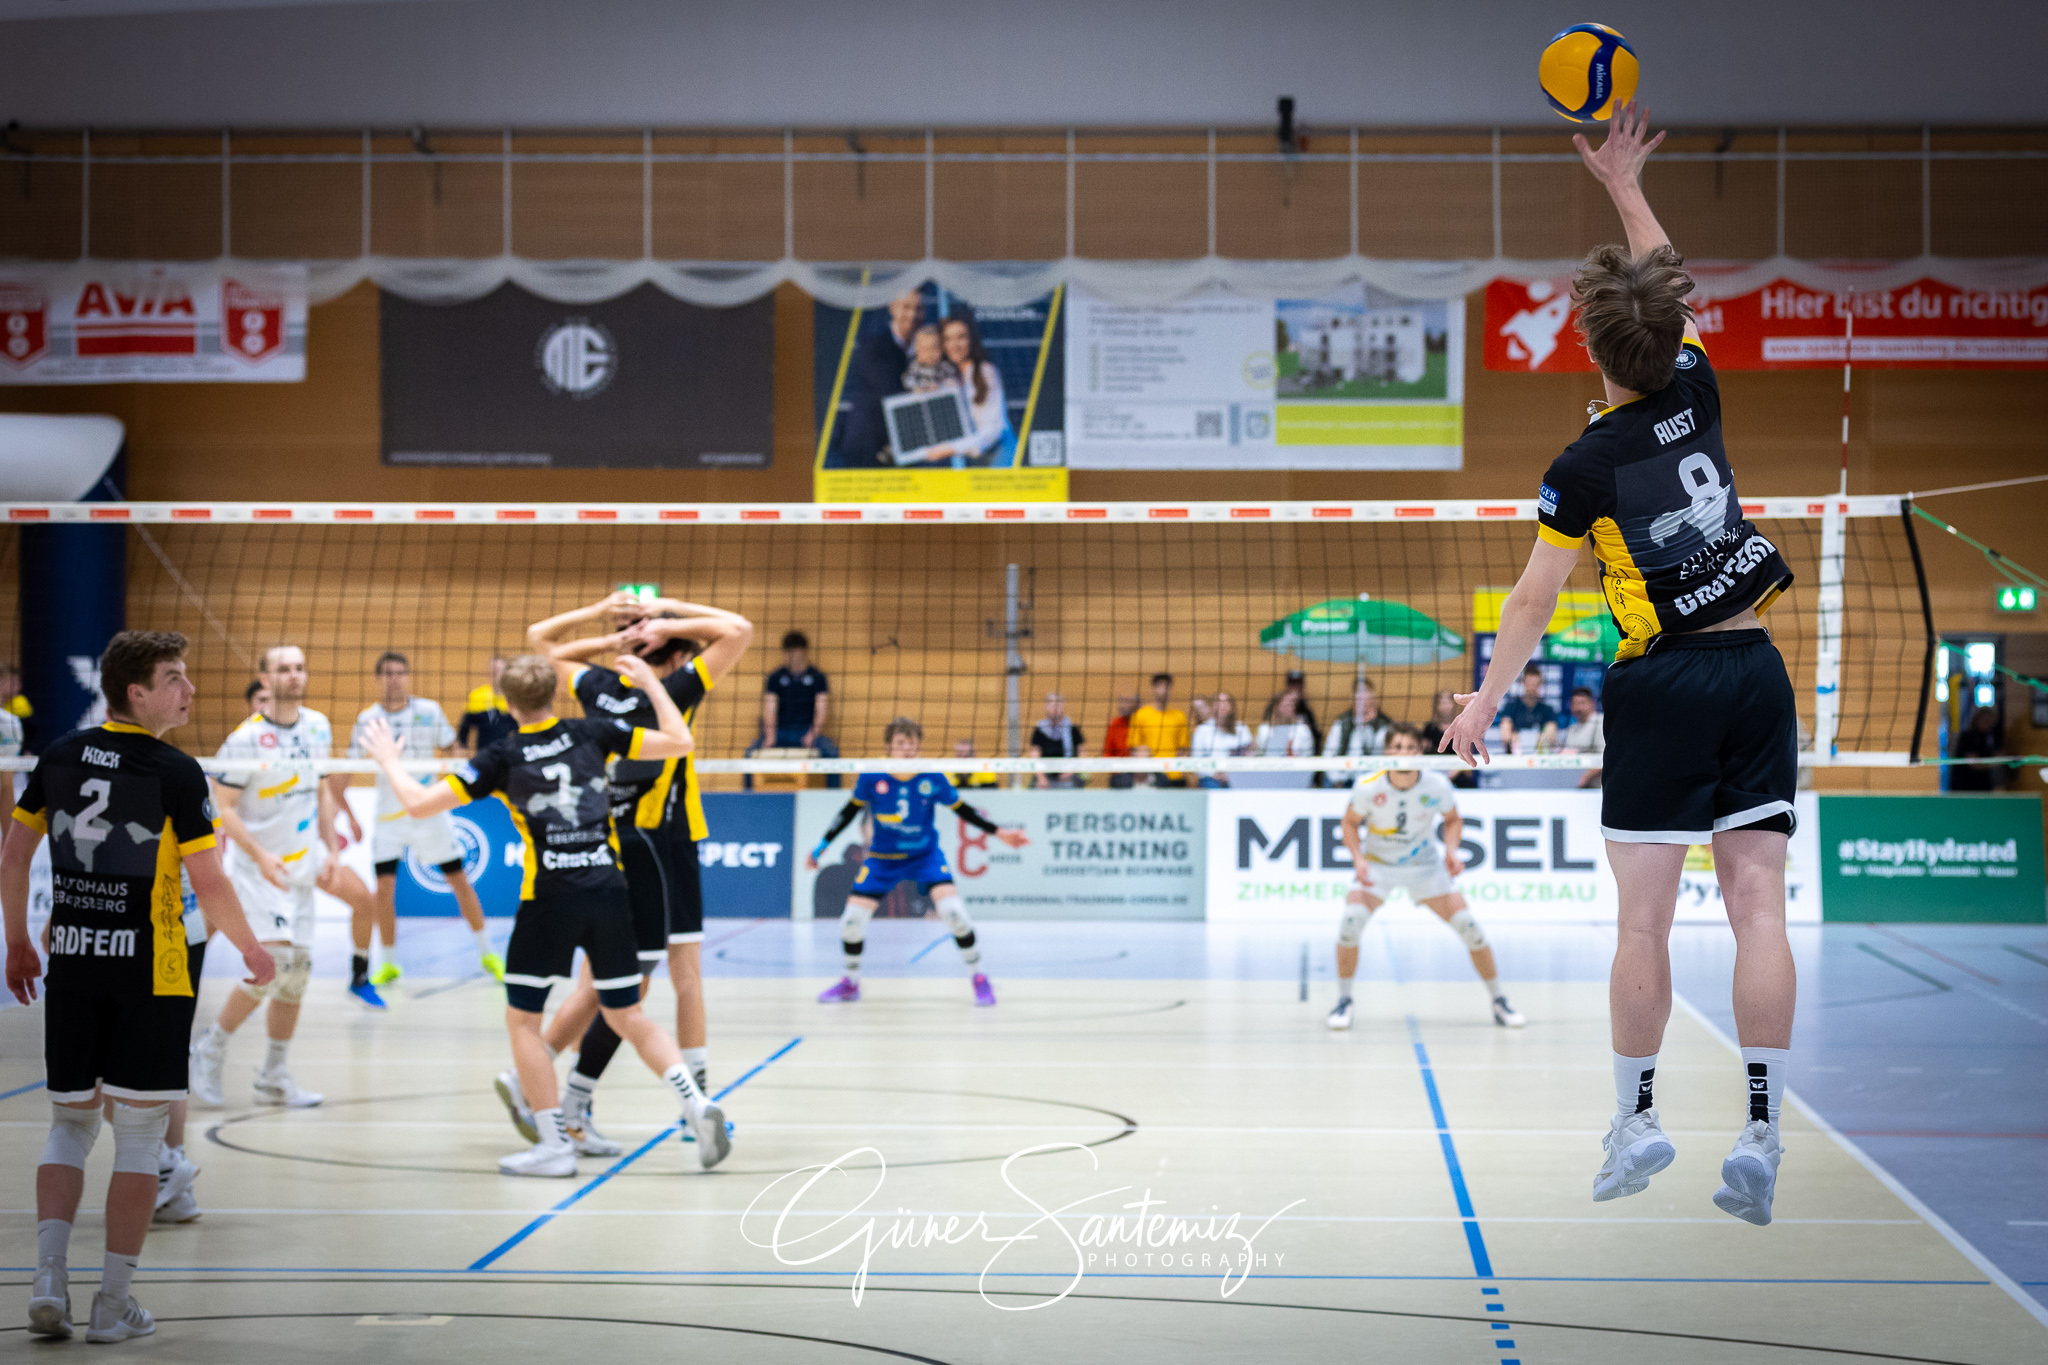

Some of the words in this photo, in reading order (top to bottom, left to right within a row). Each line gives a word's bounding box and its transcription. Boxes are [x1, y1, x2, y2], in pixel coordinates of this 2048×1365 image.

[75, 267, 197, 318] AVIA
[1761, 287, 1824, 319] Hier
[1899, 287, 1942, 319] du
[1949, 287, 2048, 327] richtig
[1654, 408, 1696, 445] AUST
[1678, 452, 1722, 520] 8
[72, 777, 112, 842] 2
[1045, 813, 1193, 833] PERSONAL
[698, 841, 784, 868] PECT
[1050, 840, 1189, 861] TRAINING
[1839, 838, 2018, 867] #StayHydrated
